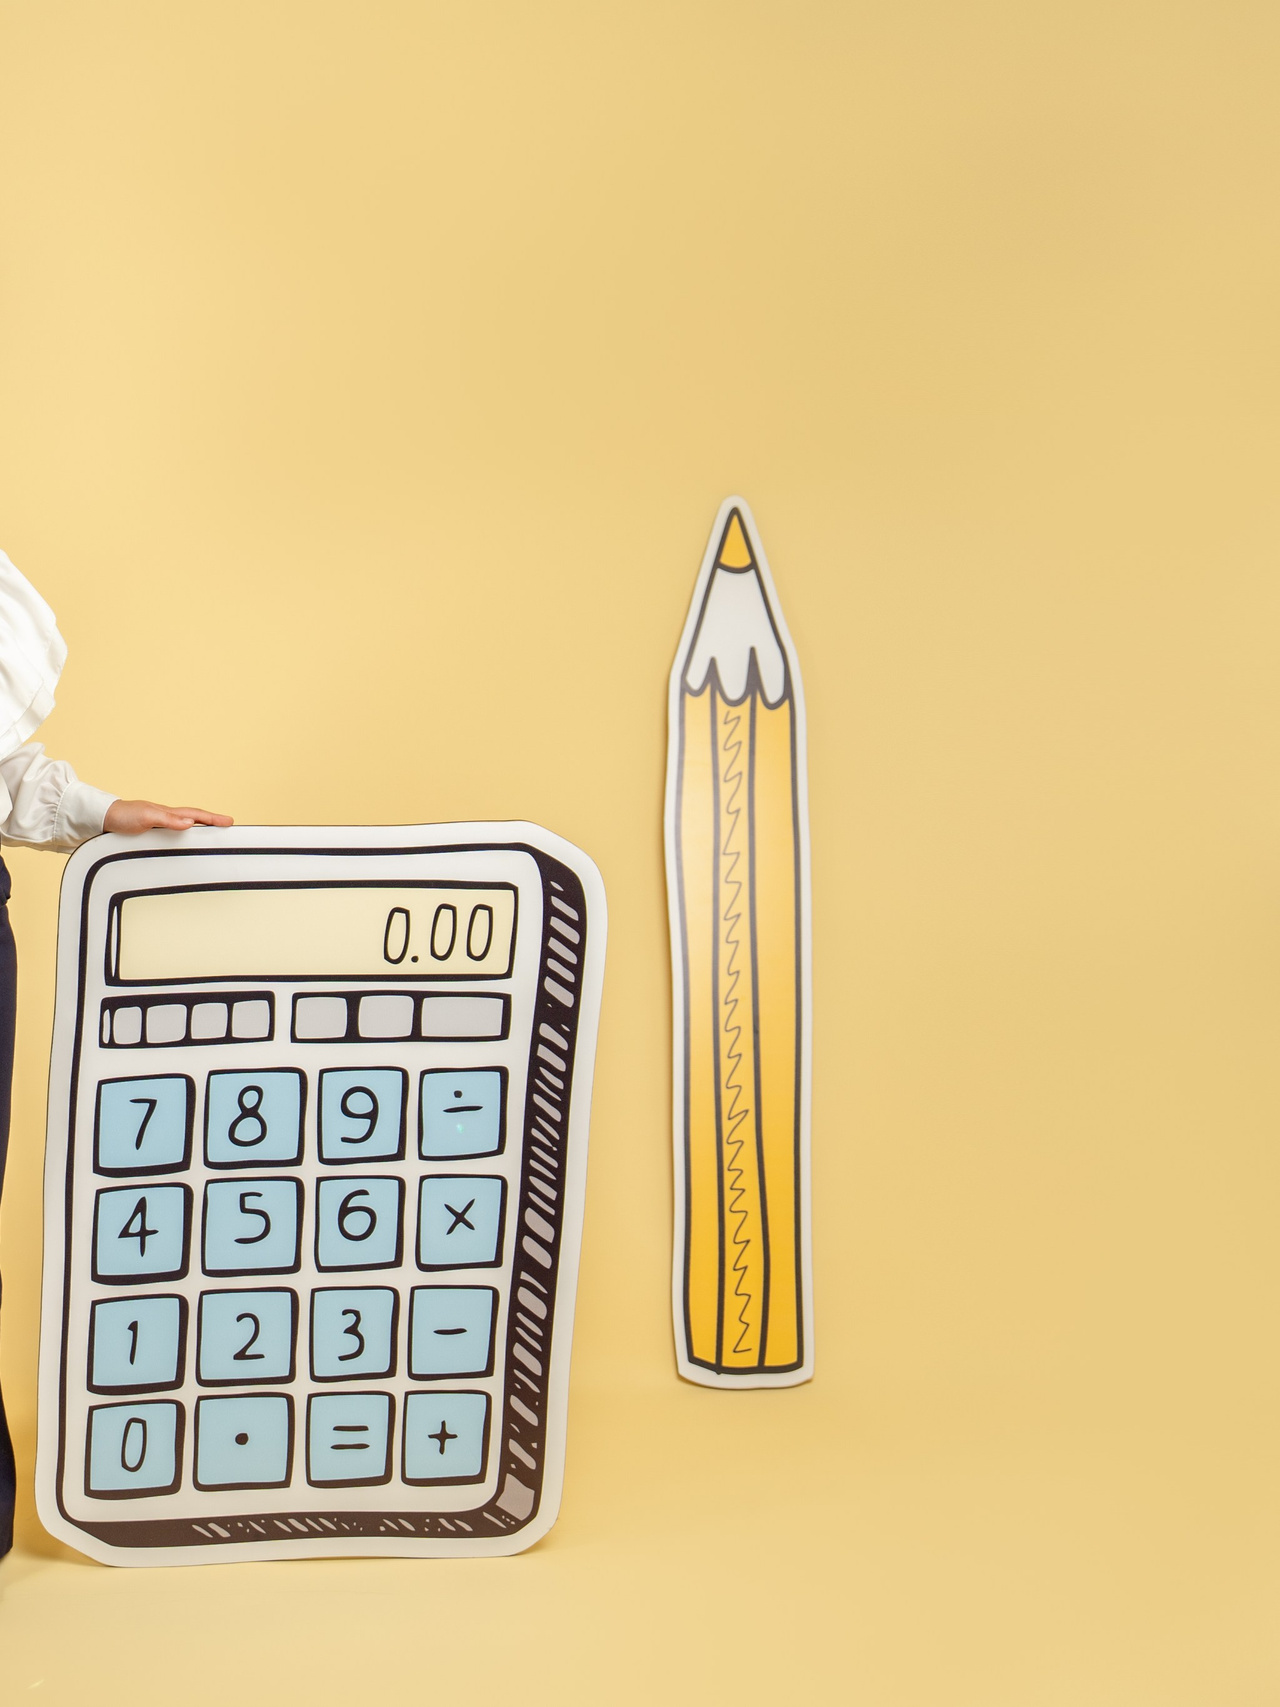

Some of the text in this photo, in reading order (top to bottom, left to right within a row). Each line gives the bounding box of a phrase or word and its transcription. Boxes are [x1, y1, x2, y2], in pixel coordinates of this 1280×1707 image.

[383, 903, 494, 965] 0.00
[129, 1098, 158, 1151] 7
[227, 1084, 268, 1148] 8
[340, 1085, 379, 1144] 9
[117, 1196, 160, 1258] 4
[233, 1191, 271, 1245] 5
[337, 1189, 377, 1242] 6
[127, 1320, 139, 1366] 1
[232, 1312, 266, 1361] 2
[337, 1308, 365, 1362] 3
[120, 1417, 148, 1473] 0
